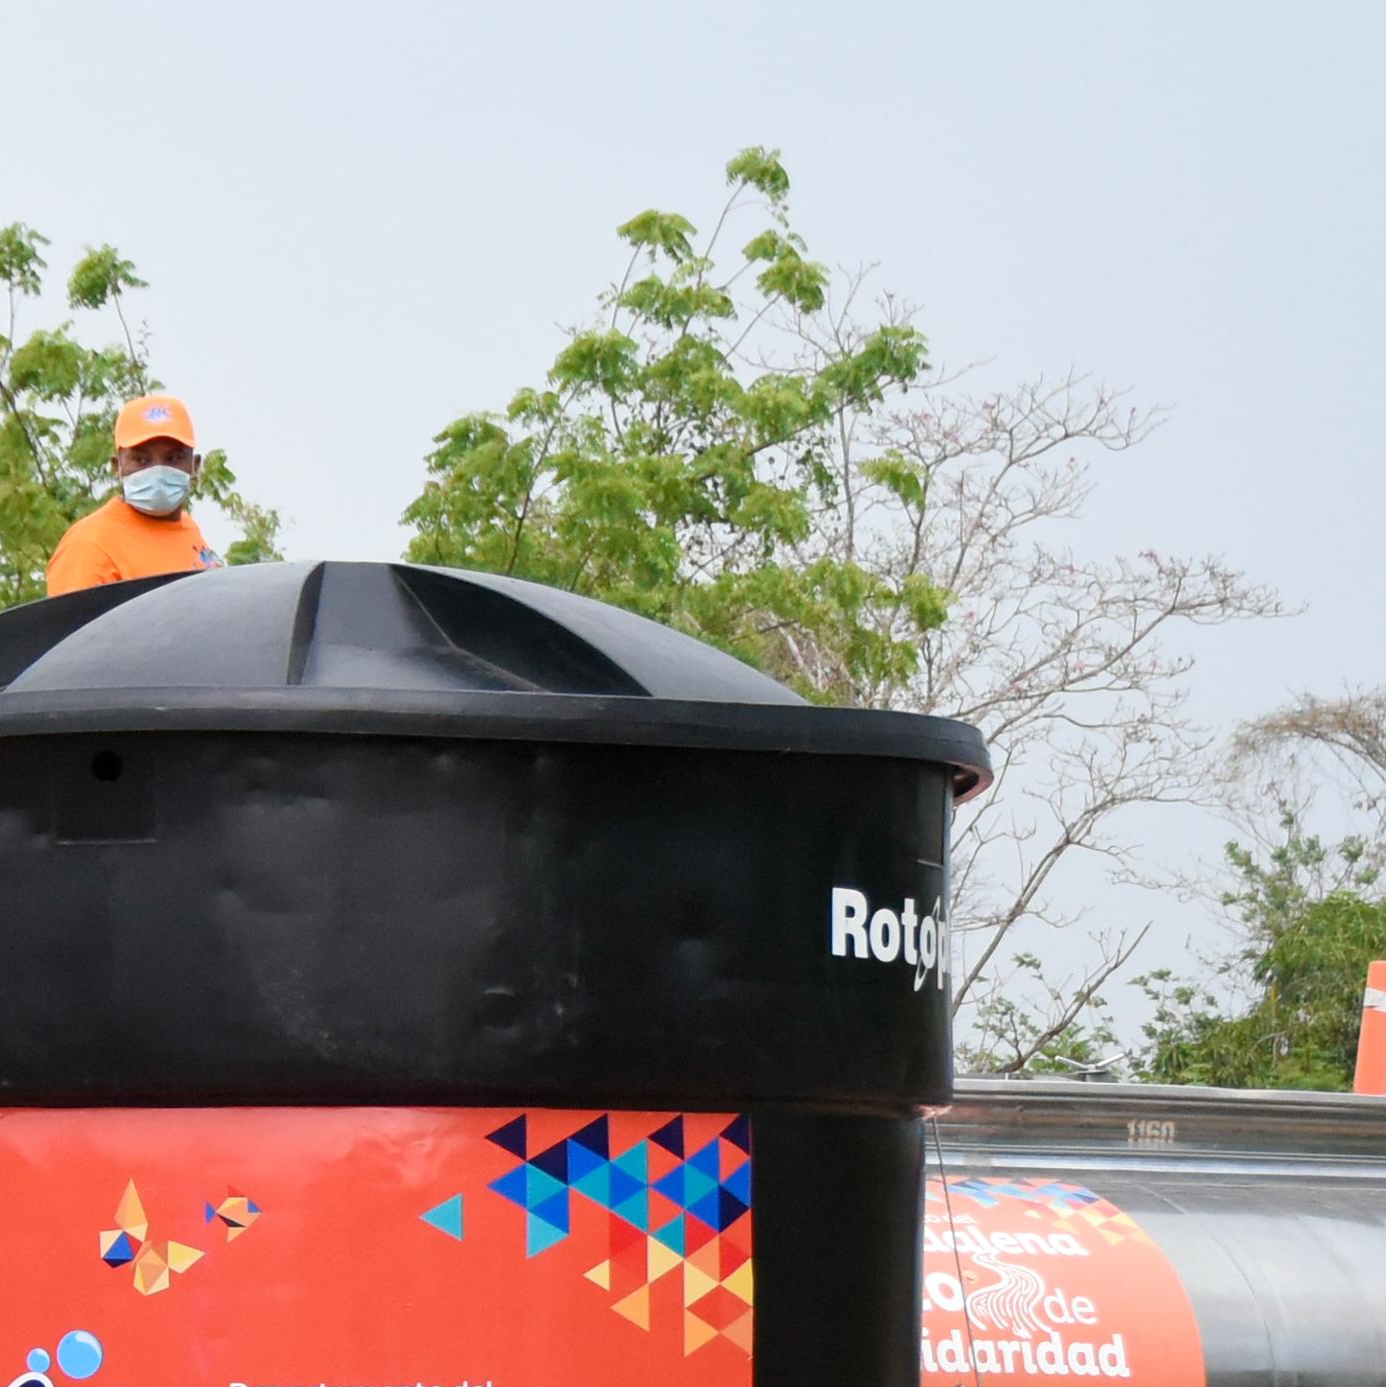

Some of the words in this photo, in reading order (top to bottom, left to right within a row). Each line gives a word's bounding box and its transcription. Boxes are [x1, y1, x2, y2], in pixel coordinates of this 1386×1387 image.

[831, 887, 950, 991] Rotop
[923, 1225, 1091, 1256] dalena
[1043, 1287, 1098, 1325] de
[920, 1329, 1131, 1377] idaridad
